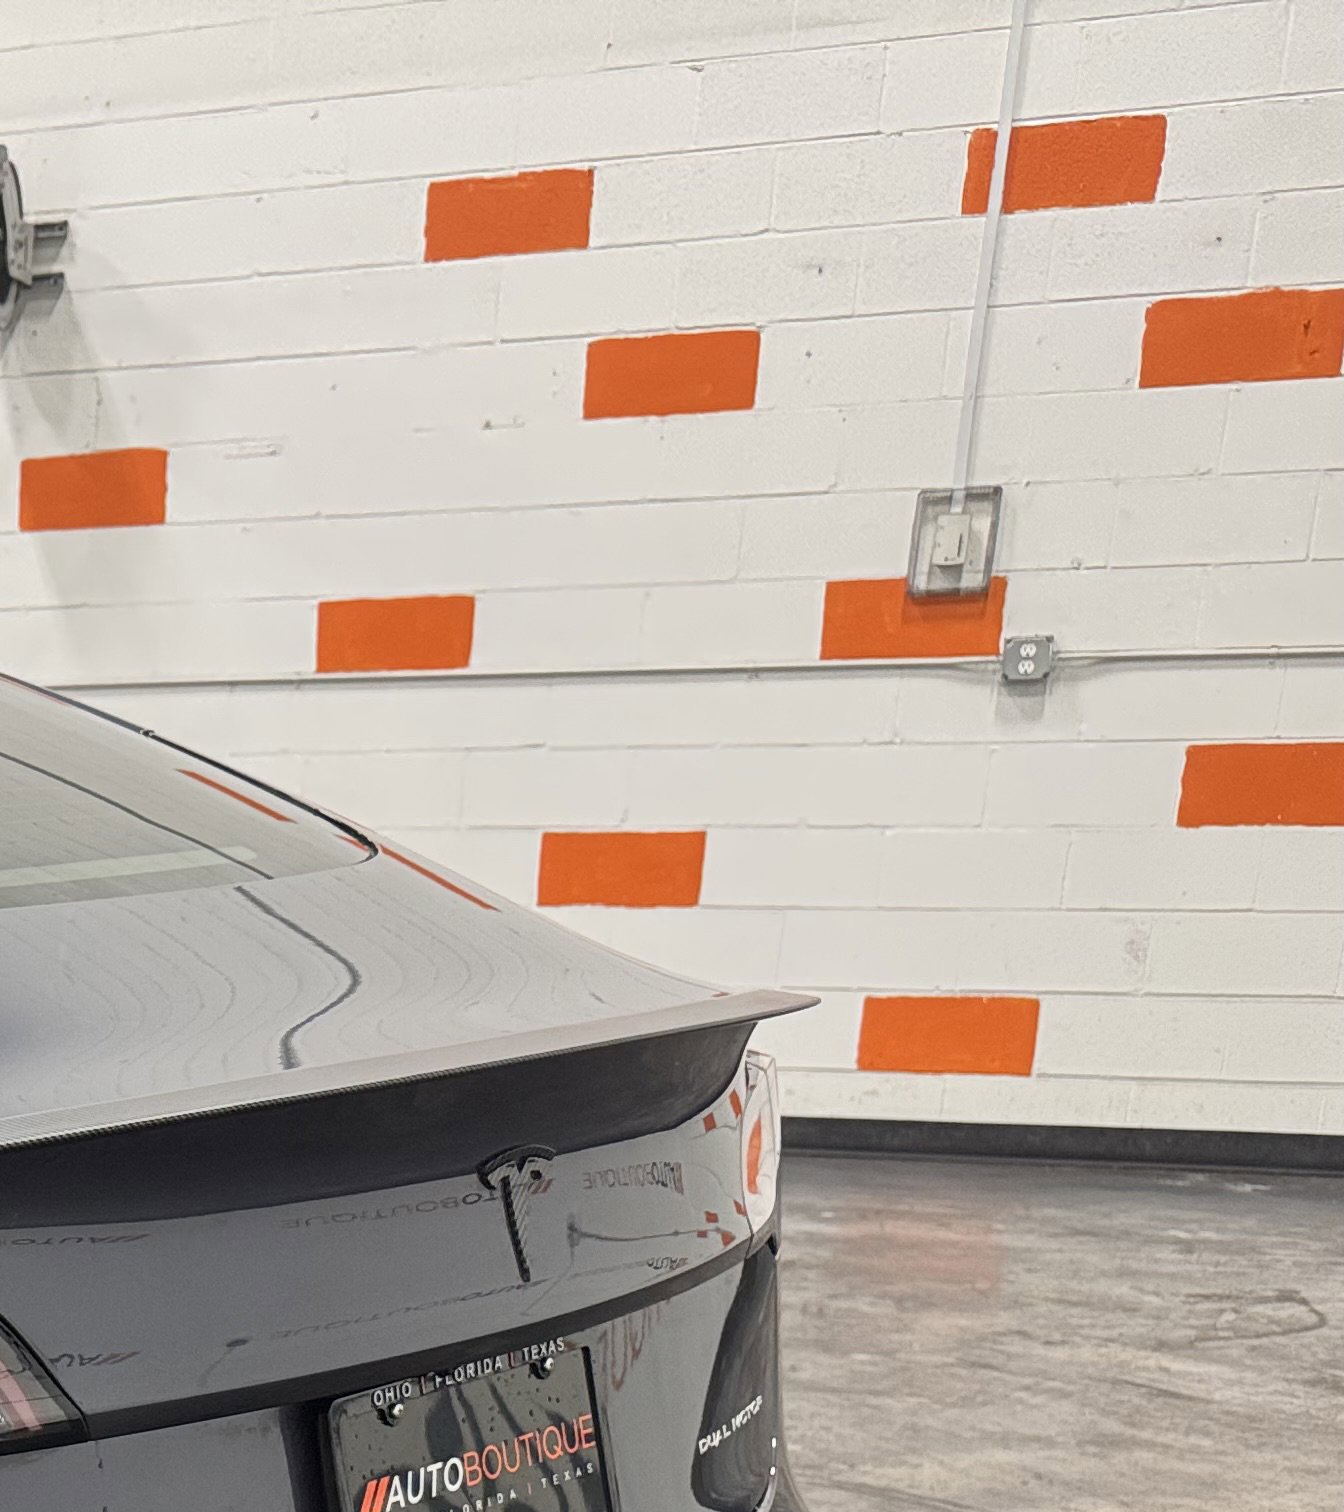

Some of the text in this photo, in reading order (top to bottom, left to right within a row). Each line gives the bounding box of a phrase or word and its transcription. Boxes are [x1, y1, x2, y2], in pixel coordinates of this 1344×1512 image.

[372, 1336, 567, 1407] OHIO FLORIDA TEXAS
[540, 1462, 594, 1489] TEXAS
